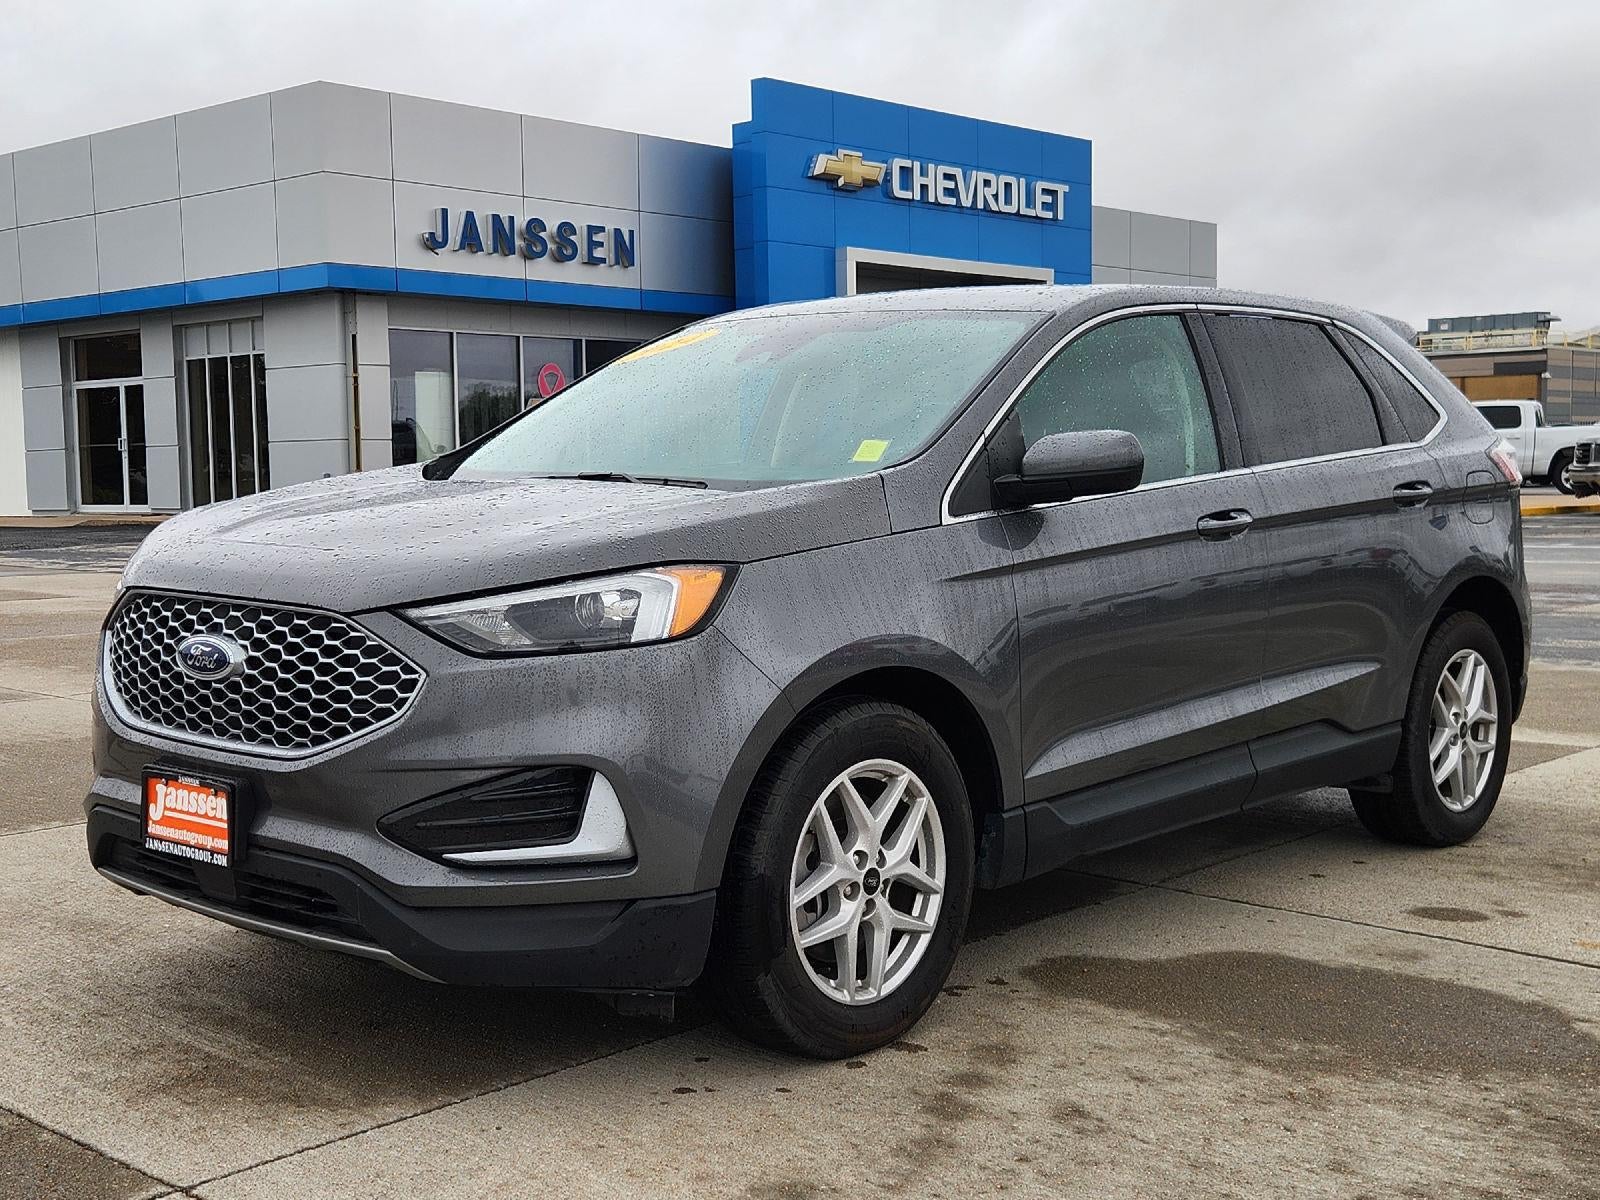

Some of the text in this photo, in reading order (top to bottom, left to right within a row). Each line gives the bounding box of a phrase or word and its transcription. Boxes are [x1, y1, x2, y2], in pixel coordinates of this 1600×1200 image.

[892, 158, 1069, 220] CHEVROLET
[422, 208, 635, 268] JANSSEN
[187, 644, 219, 668] Ford
[149, 784, 227, 820] Janssen
[145, 838, 227, 867] JANSSENAUTOGROUP.COM
